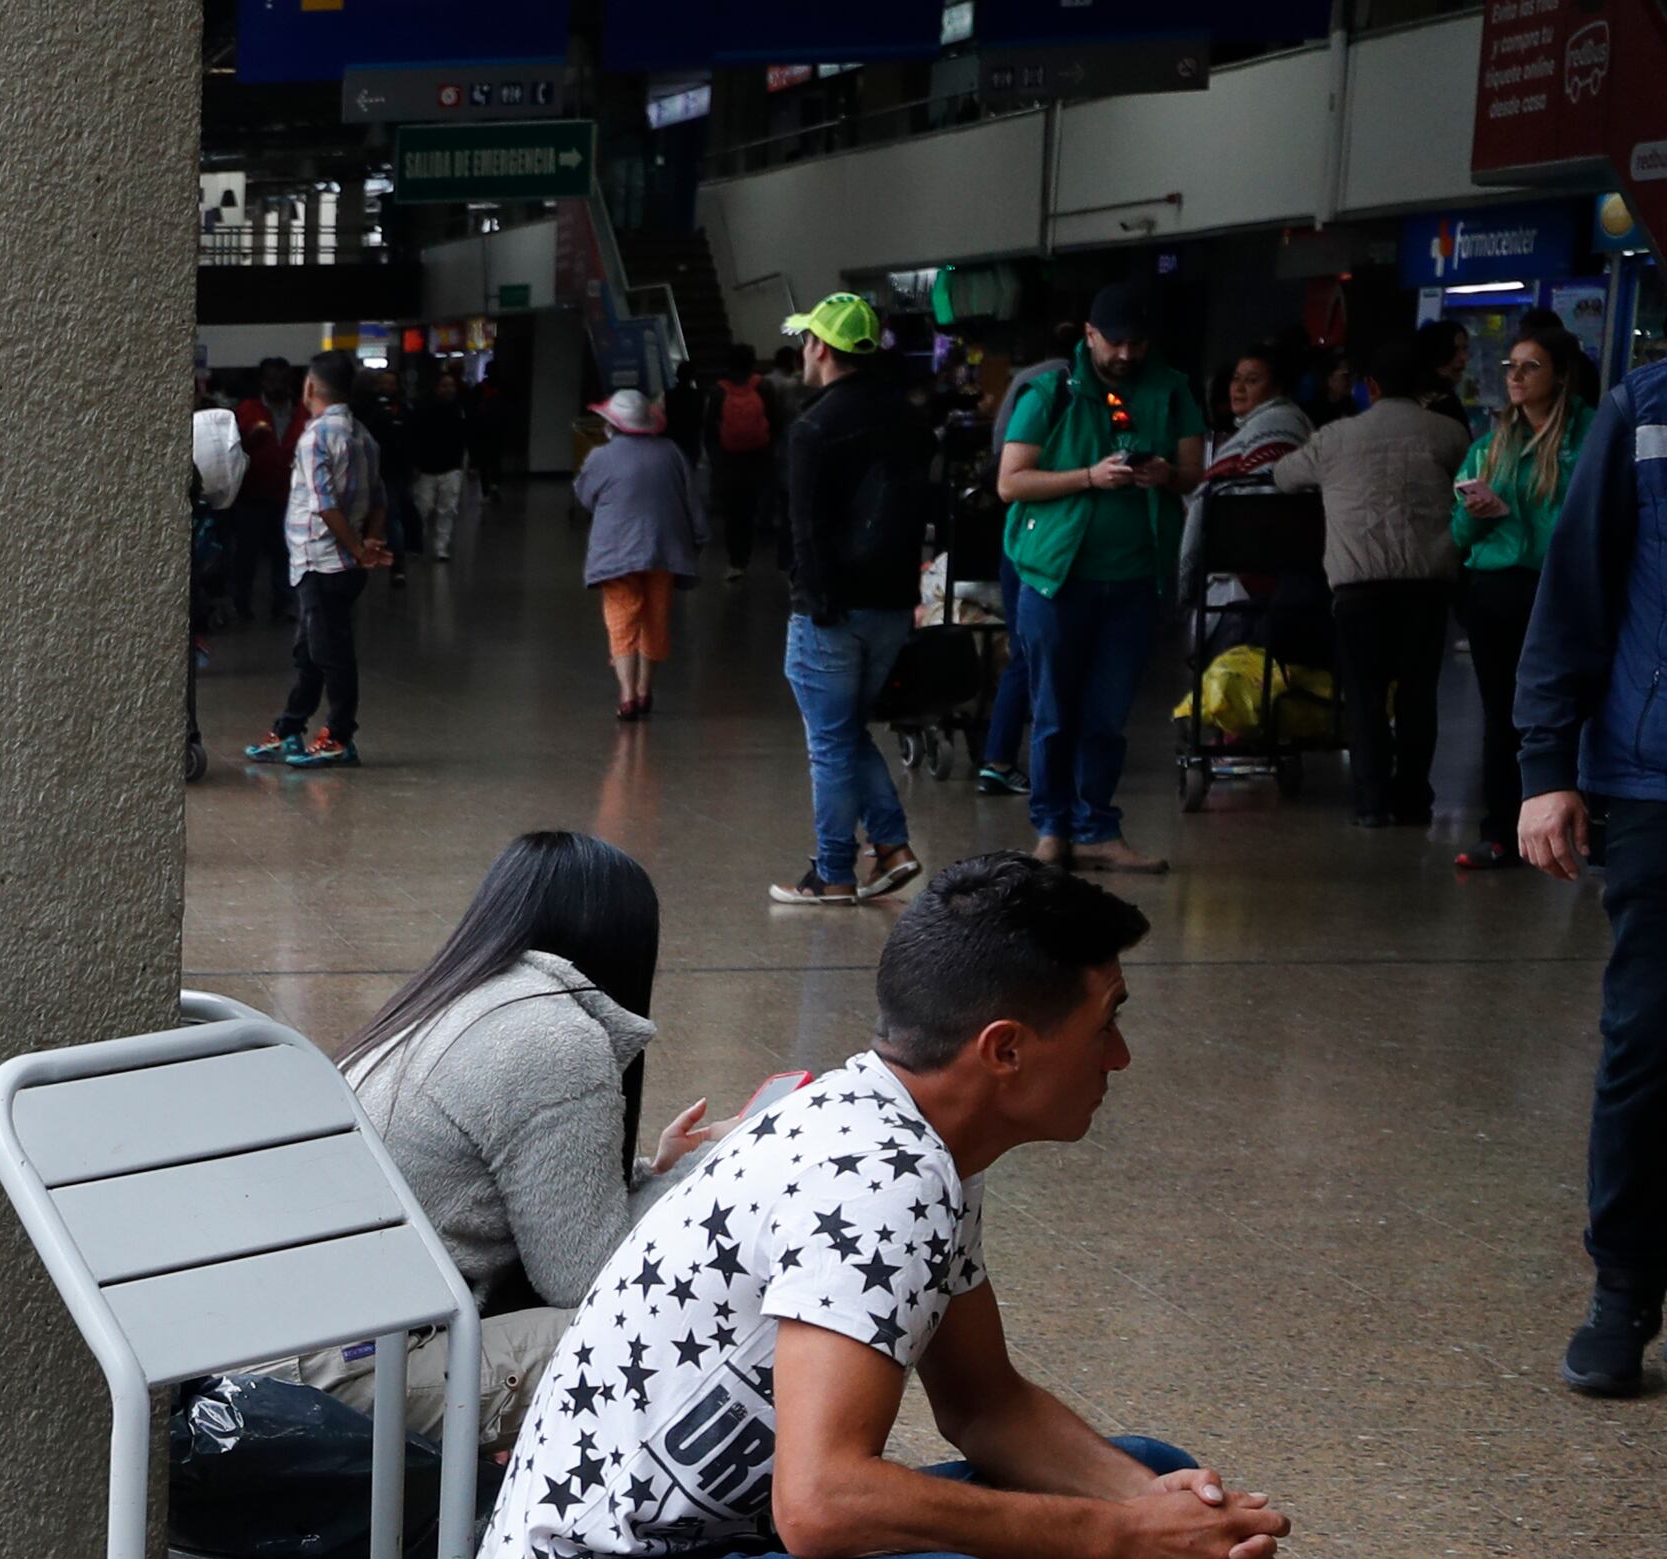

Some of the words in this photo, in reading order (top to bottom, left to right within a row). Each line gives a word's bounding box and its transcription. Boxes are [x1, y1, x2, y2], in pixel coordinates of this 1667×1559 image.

[1491, 4, 1518, 24] Evita
[1520, 1, 1535, 17] las
[1500, 30, 1541, 54] compra
[1541, 25, 1554, 44] tu
[1523, 55, 1555, 80] online
[1489, 94, 1520, 119] desde
[1521, 93, 1547, 113] casa
[404, 150, 450, 180] SALIDA
[453, 149, 469, 178] DE
[472, 146, 557, 178] EMERGENCIA
